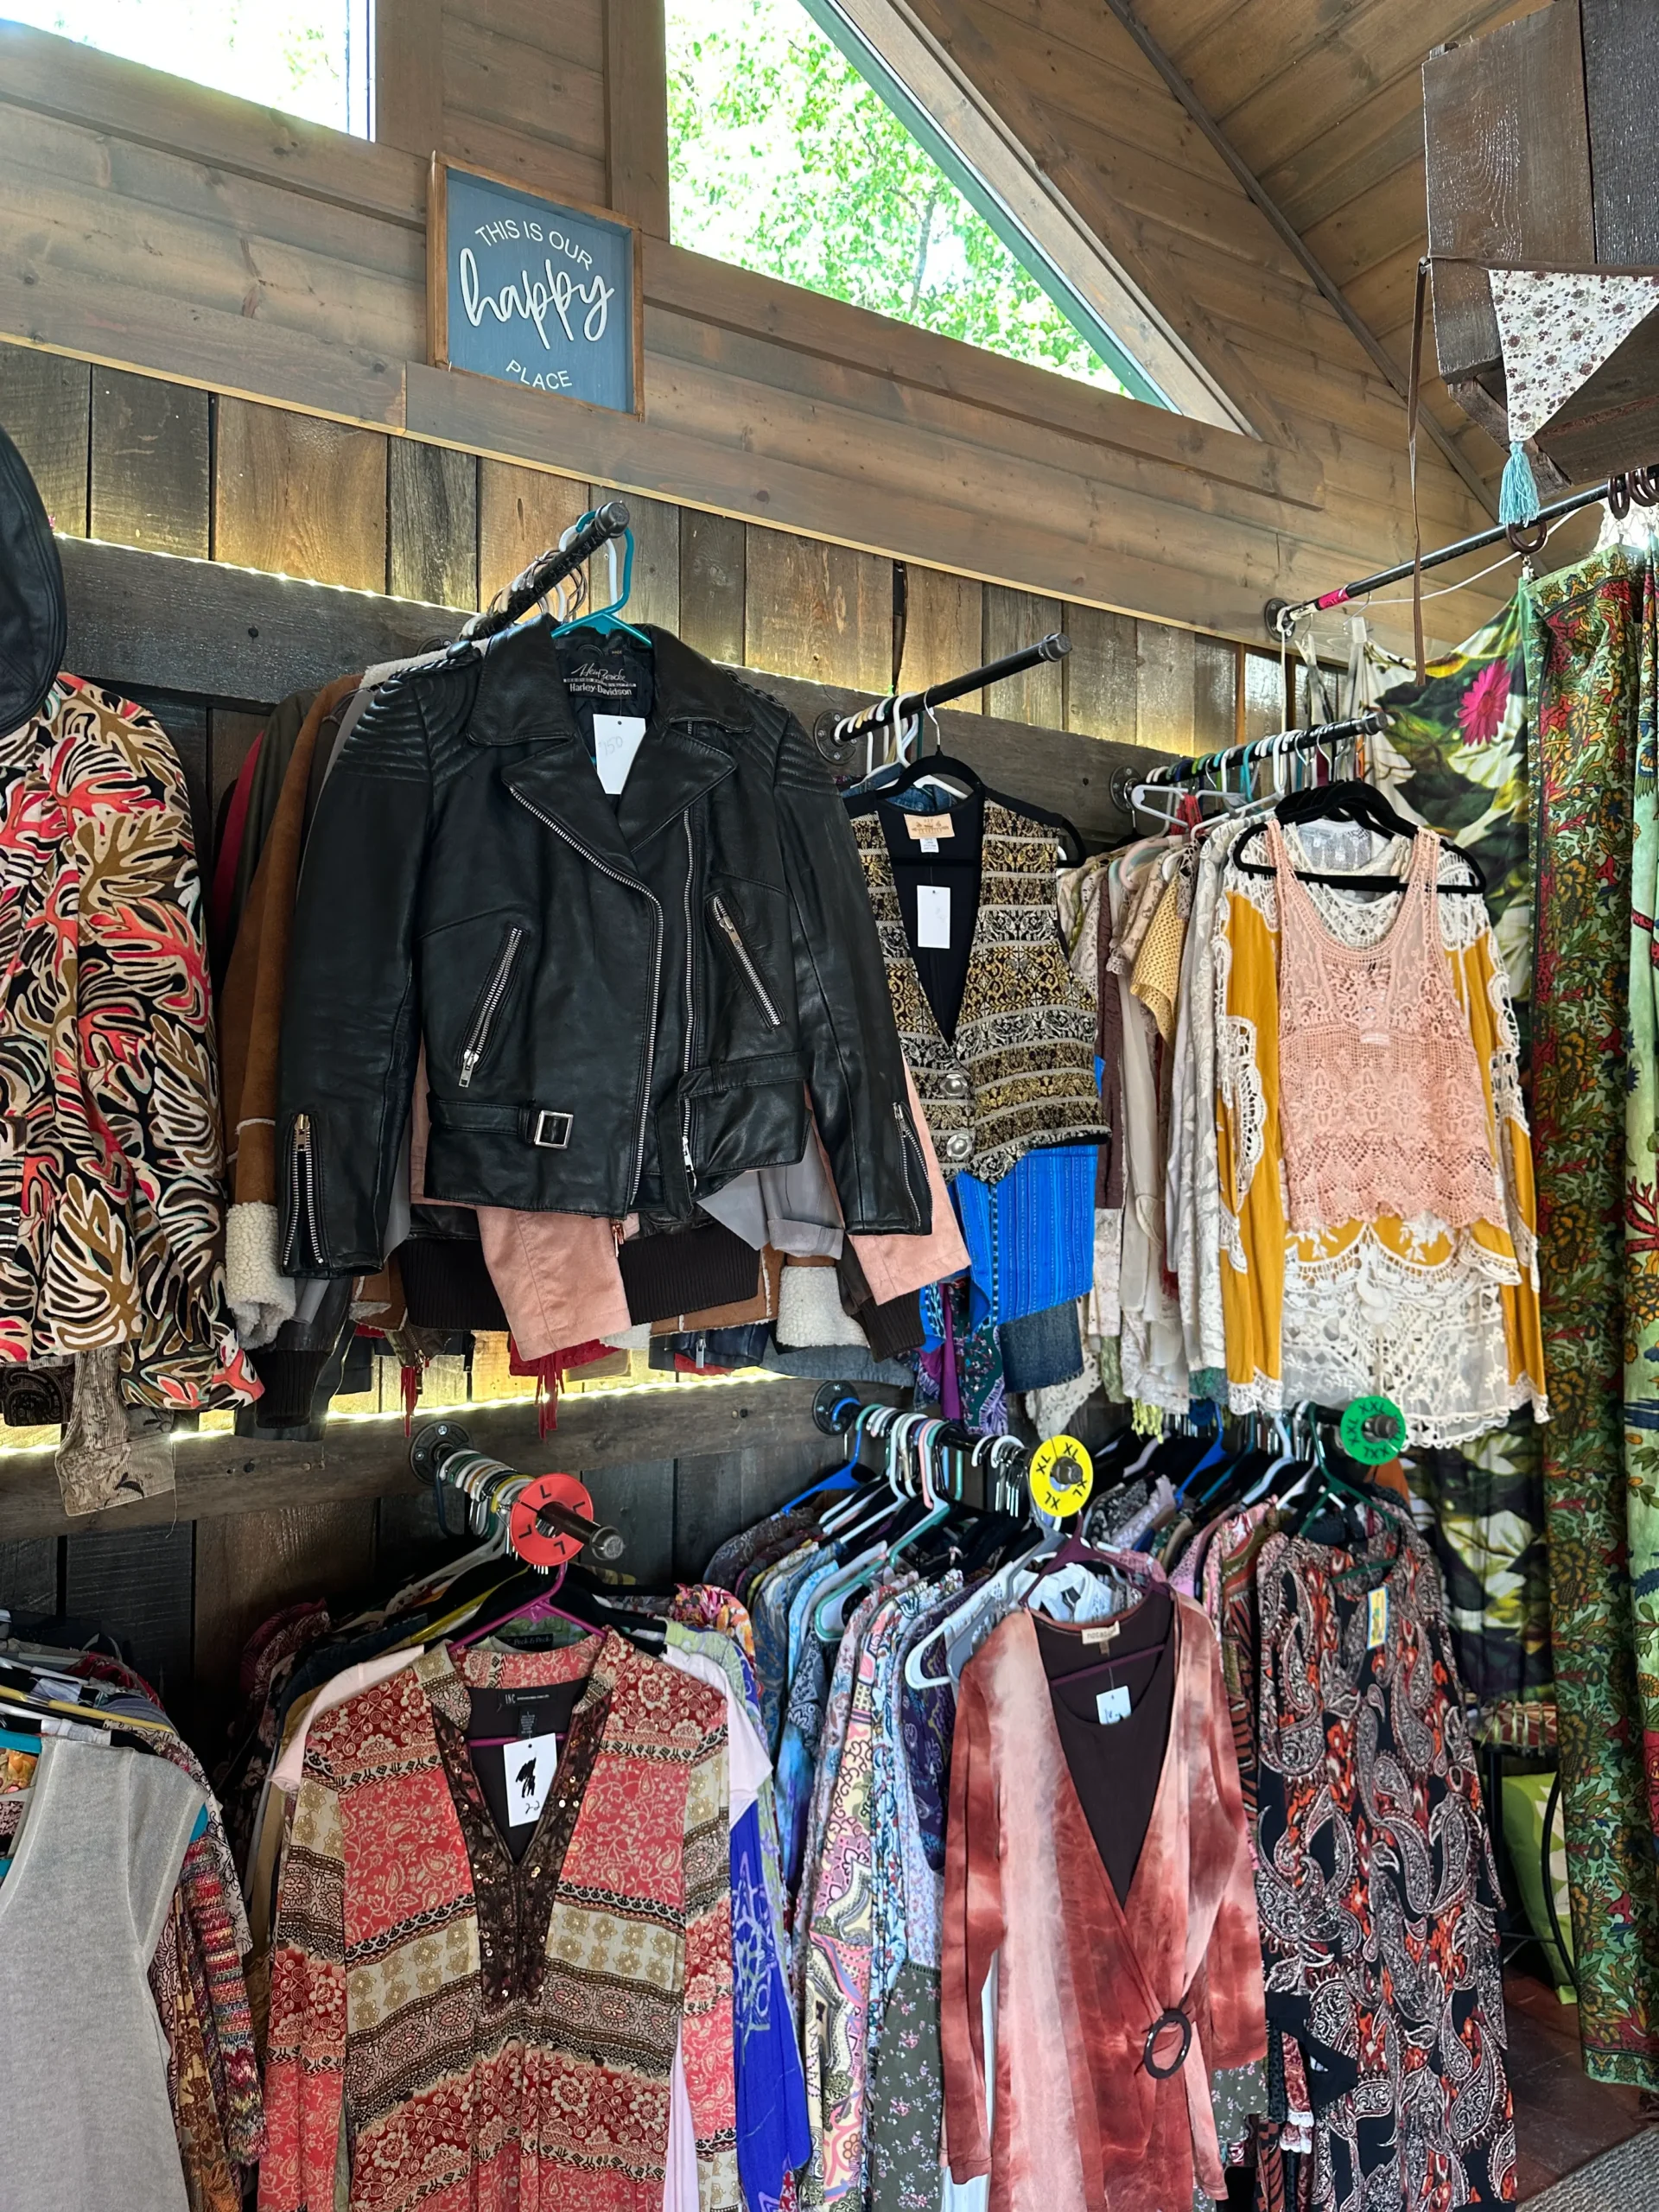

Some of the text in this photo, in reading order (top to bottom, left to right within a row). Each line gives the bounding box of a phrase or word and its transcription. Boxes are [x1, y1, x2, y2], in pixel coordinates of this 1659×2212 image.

[474, 219, 593, 271] THIS IS OUR
[460, 248, 614, 350] happy
[505, 359, 573, 391] PLACE
[1357, 1401, 1386, 1415] XXL
[1346, 1418, 1361, 1446] XXL
[1063, 1442, 1079, 1461] XL
[1363, 1446, 1390, 1459] XXL
[1036, 1455, 1052, 1475] XL
[539, 1484, 551, 1499] L
[1071, 1478, 1088, 1497] XL
[572, 1501, 586, 1513] L
[1045, 1491, 1061, 1510] XL
[518, 1523, 532, 1539] L
[554, 1541, 566, 1555] L
